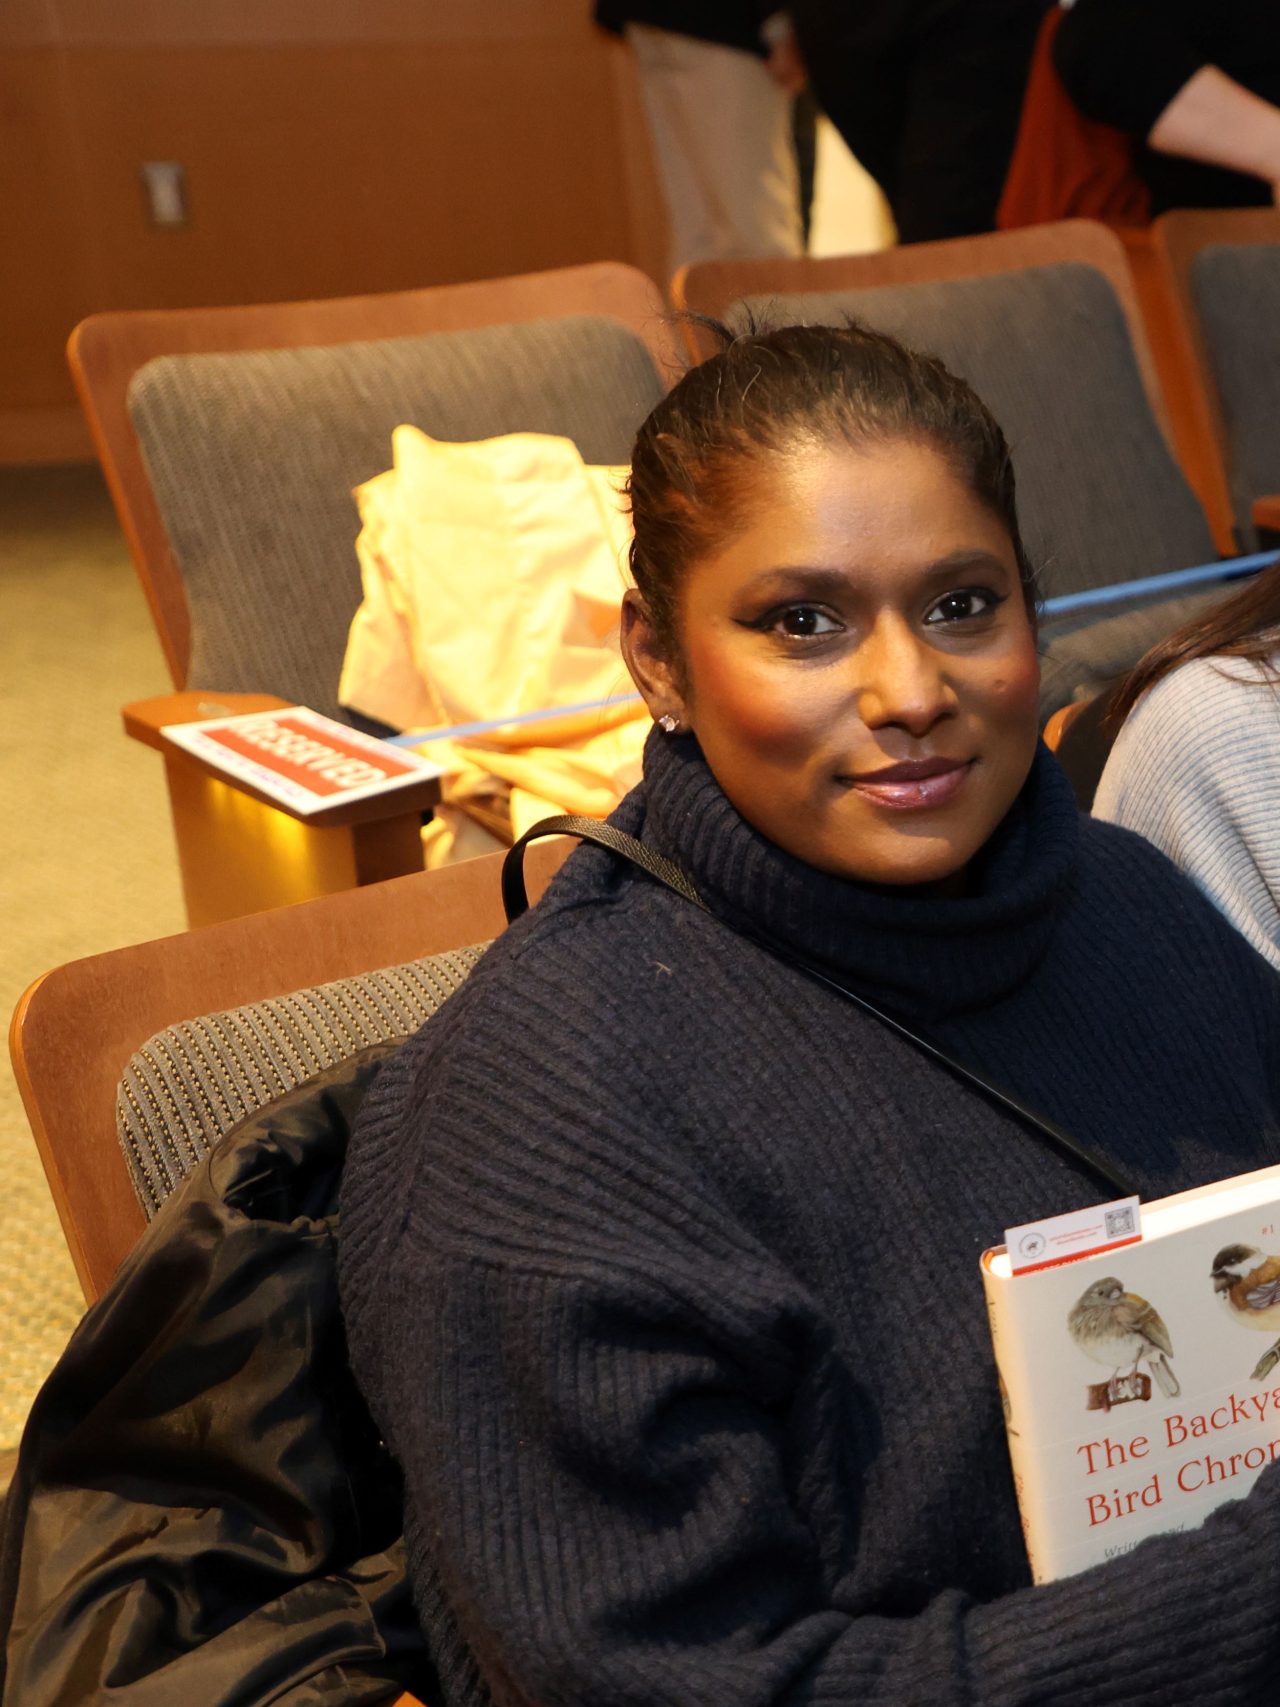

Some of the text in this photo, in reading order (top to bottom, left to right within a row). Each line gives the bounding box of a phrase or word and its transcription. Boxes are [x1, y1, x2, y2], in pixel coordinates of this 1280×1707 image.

[229, 718, 387, 787] RESERVED
[1261, 1223, 1275, 1235] #1
[1077, 1435, 1151, 1477] The
[1086, 1474, 1163, 1528] Bird
